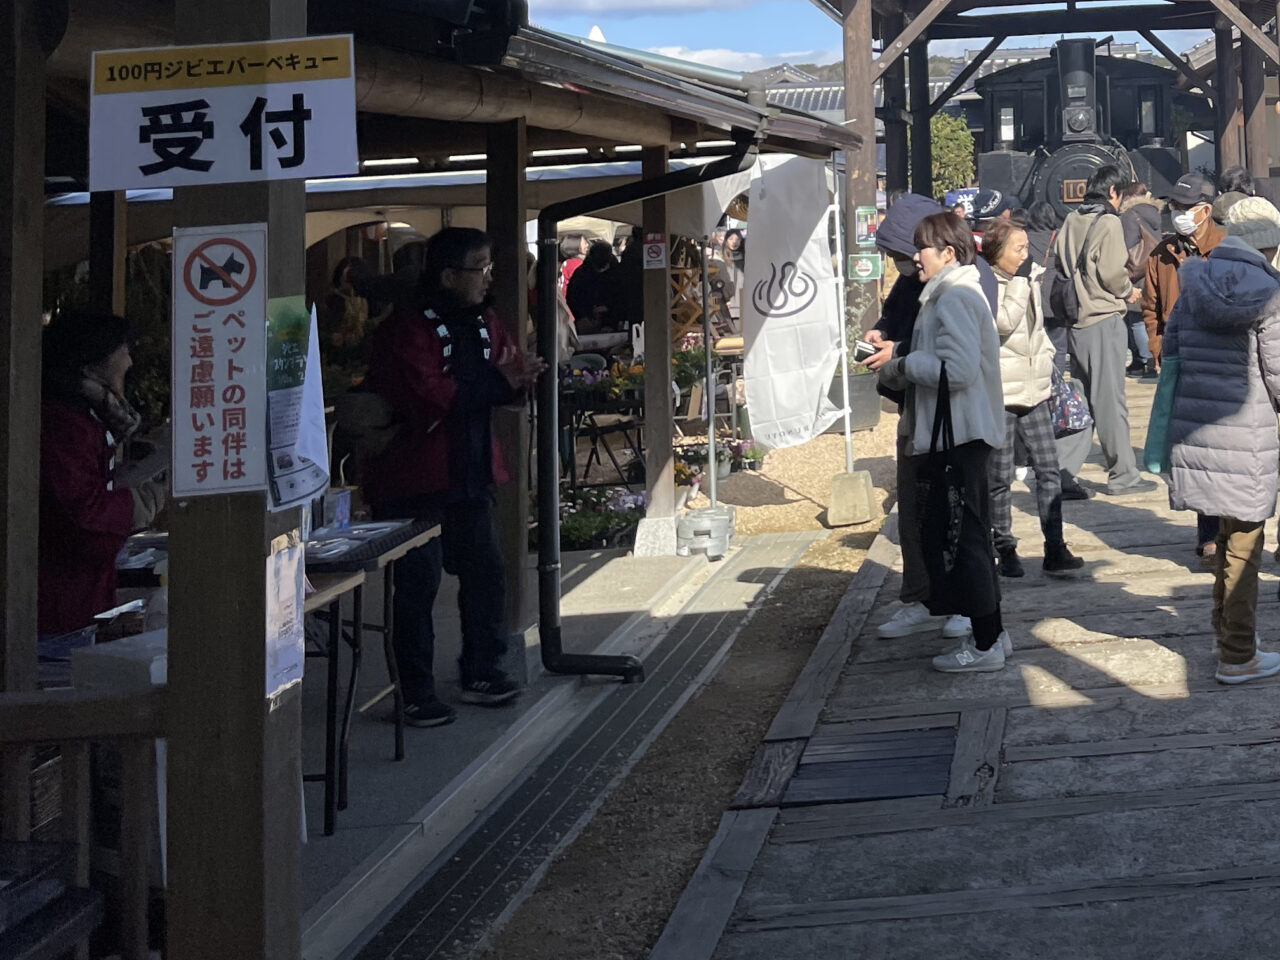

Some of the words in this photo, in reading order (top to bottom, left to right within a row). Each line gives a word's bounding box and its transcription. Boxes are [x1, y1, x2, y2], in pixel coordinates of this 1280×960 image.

[105, 53, 340, 83] 100円ジビエバーベキュー
[138, 92, 313, 177] 受付
[1068, 182, 1087, 199] 10
[190, 312, 216, 484] ご遠慮願います
[220, 309, 247, 481] ペットの同伴は
